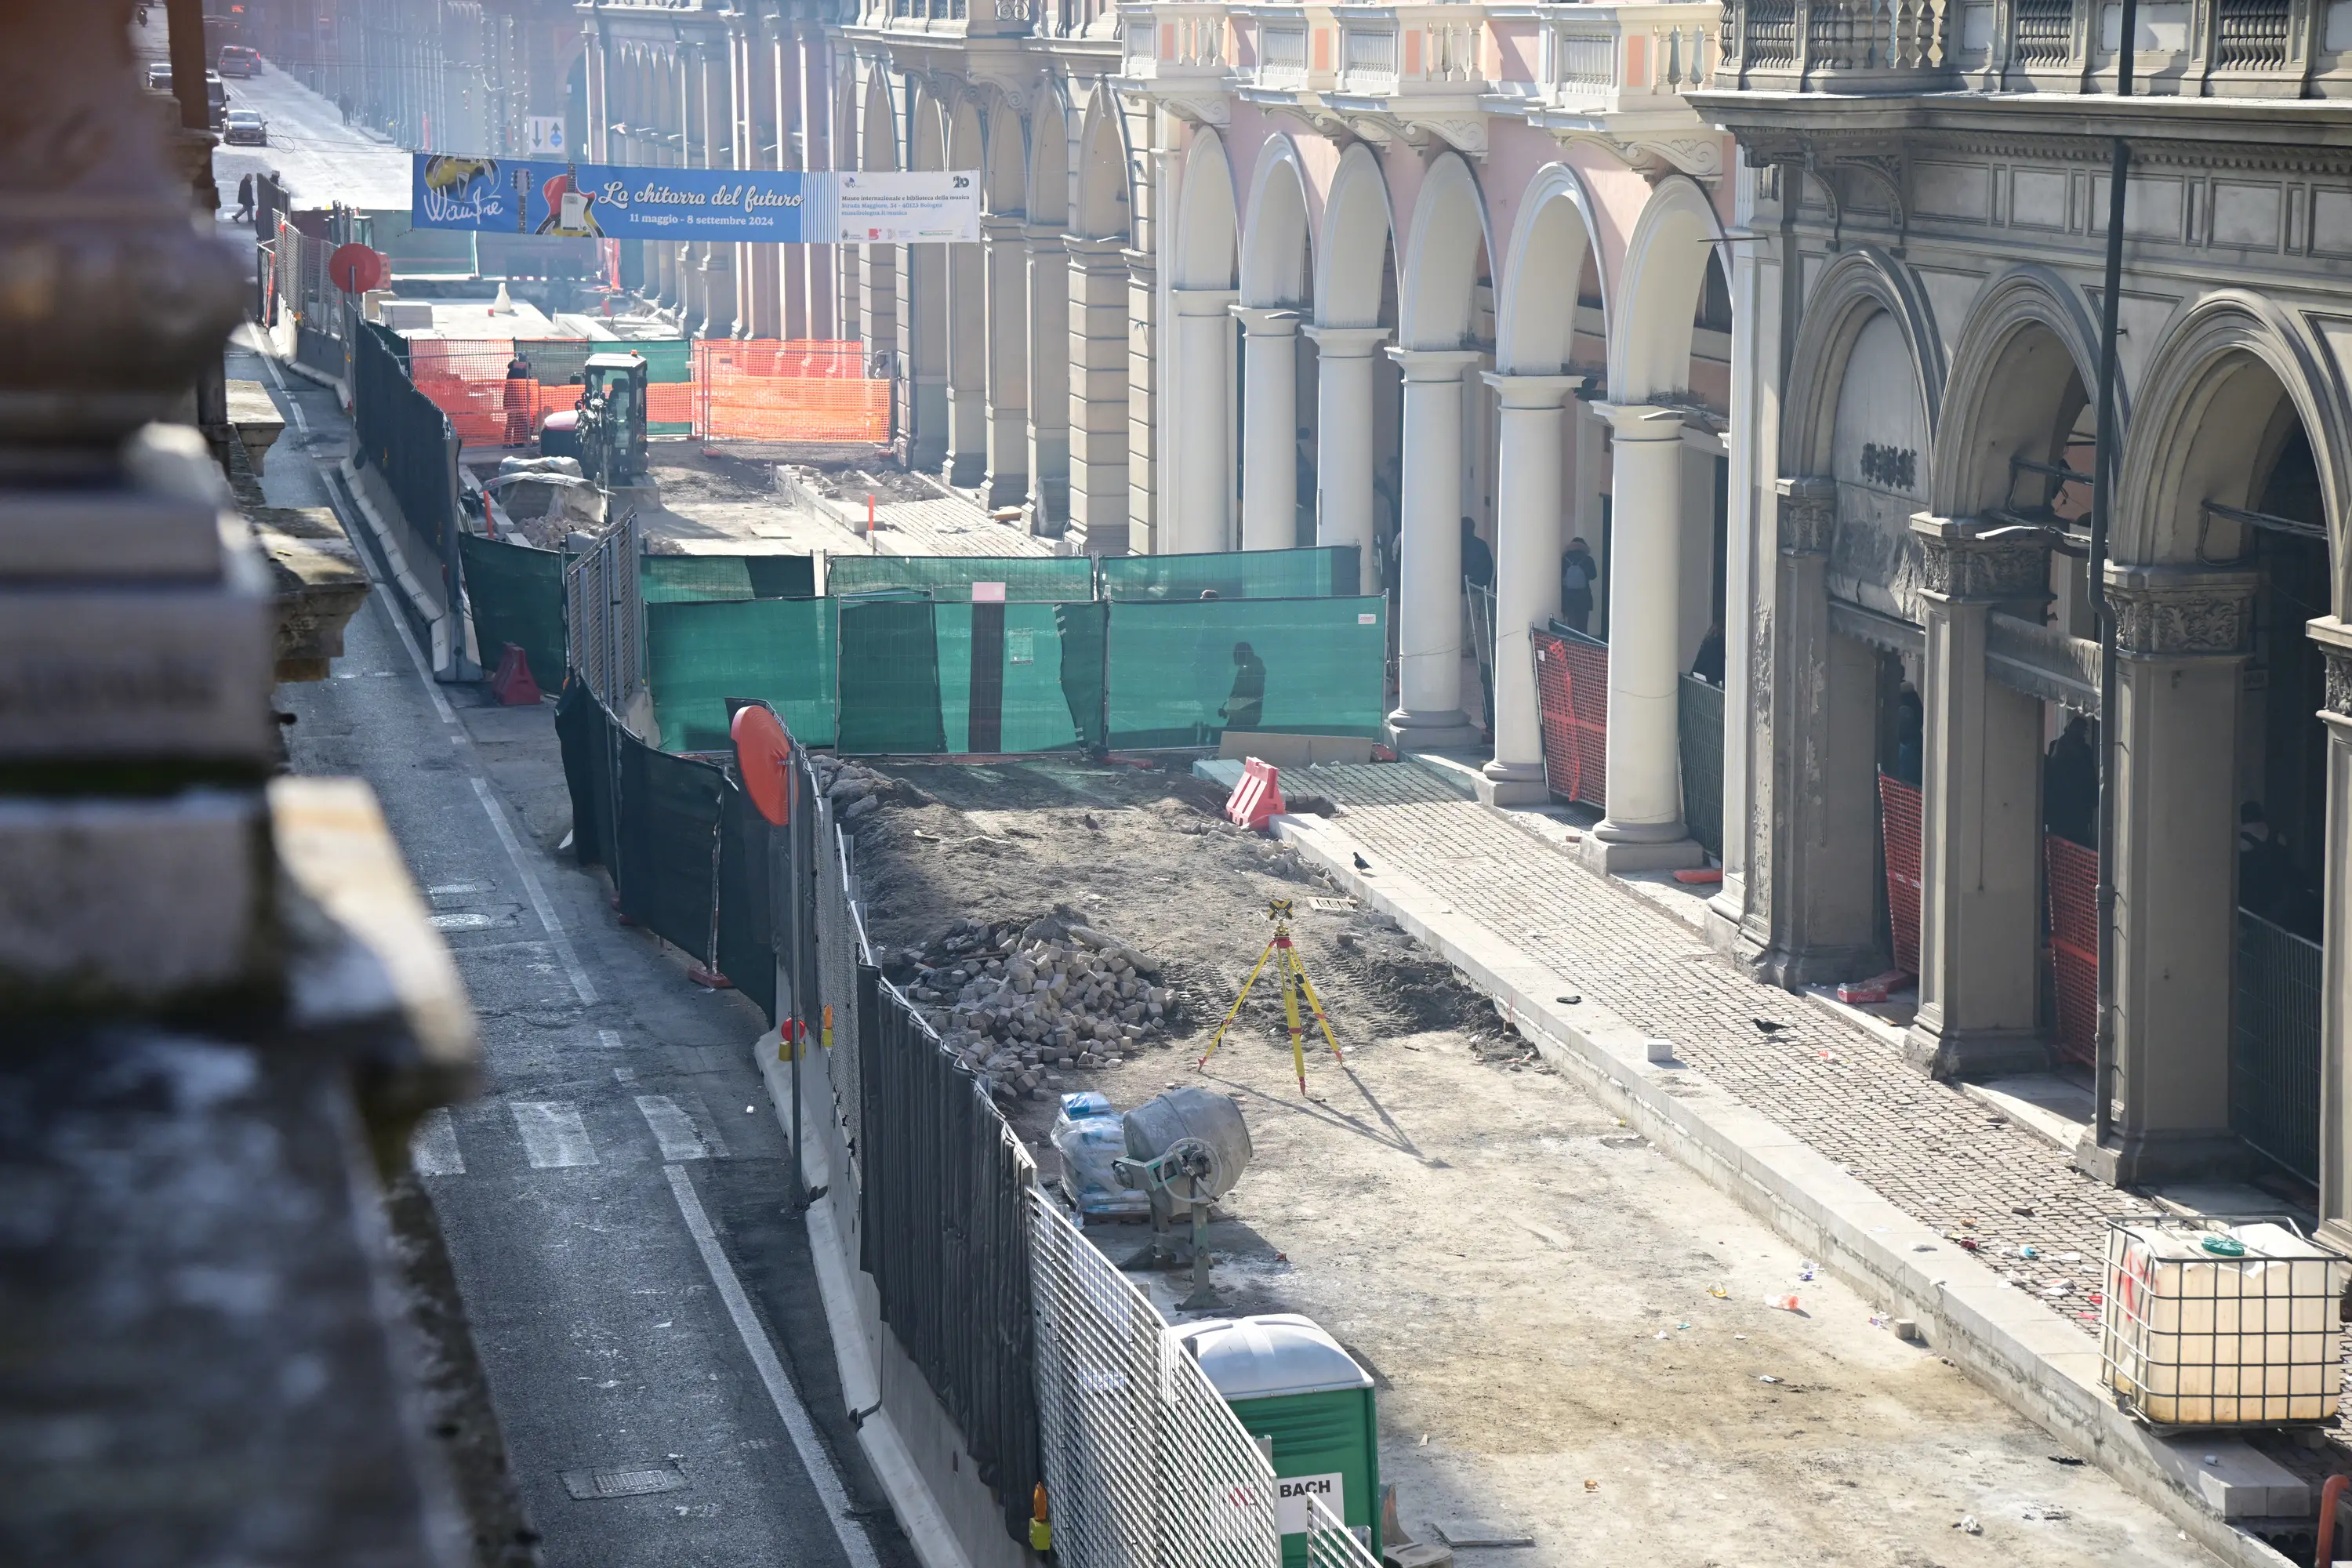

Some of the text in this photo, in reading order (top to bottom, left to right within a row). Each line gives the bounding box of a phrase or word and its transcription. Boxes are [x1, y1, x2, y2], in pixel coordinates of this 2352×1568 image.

[597, 180, 804, 213] La chitarra del futuro
[629, 213, 640, 223] 11
[641, 214, 678, 227] maggio
[687, 215, 694, 224] 8
[695, 215, 746, 226] settembre
[748, 216, 774, 227] 2024
